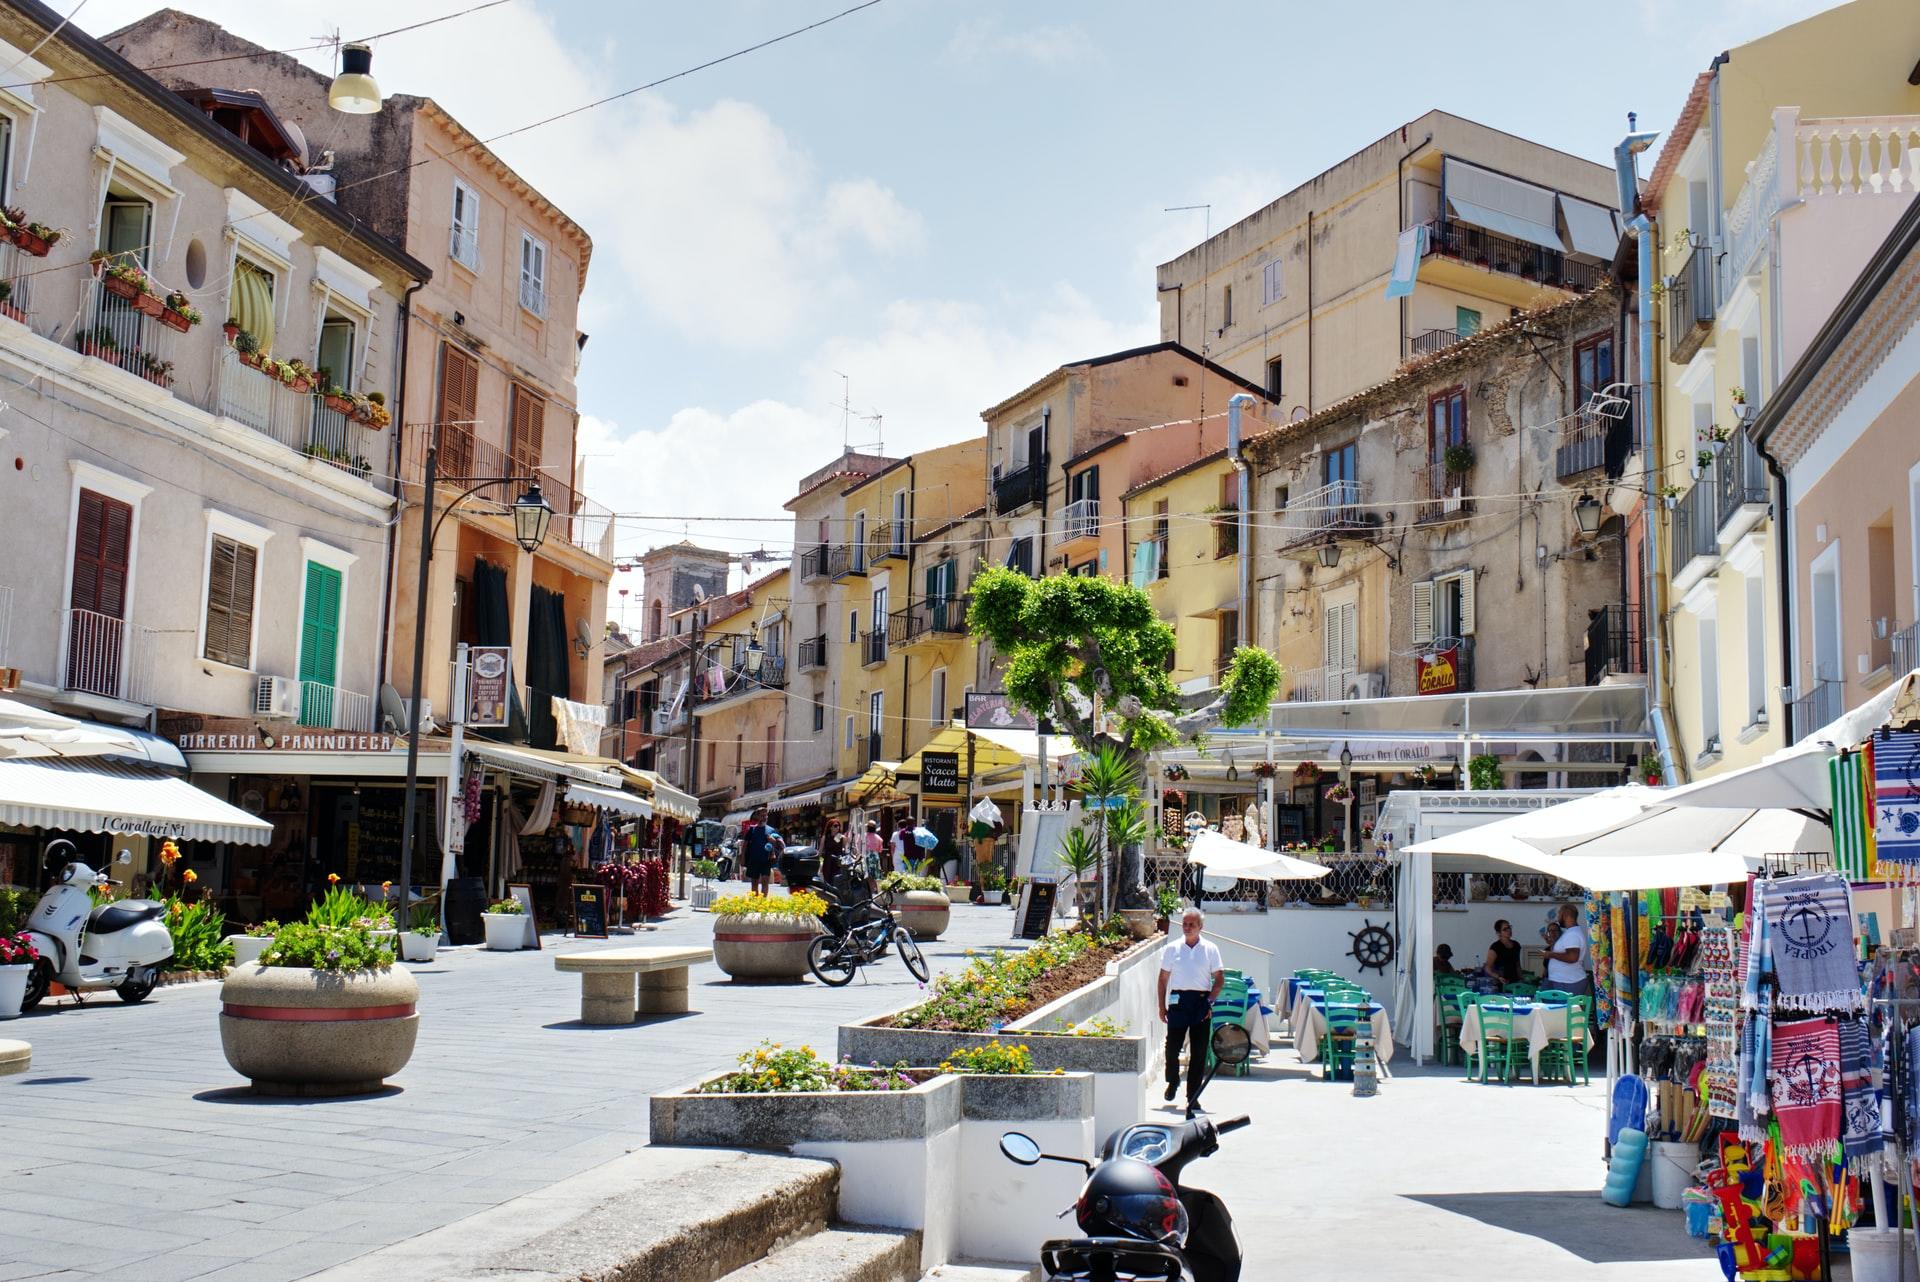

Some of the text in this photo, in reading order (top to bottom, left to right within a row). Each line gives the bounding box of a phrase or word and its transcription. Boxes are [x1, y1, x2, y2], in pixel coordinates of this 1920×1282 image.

[1421, 673, 1453, 691] CORALLO
[969, 694, 987, 702] BAR
[967, 699, 1003, 727] GELATERIA
[179, 734, 256, 749] BIRRERIA
[281, 735, 391, 751] PANINOTECA
[924, 765, 956, 776] Scacco
[925, 776, 956, 787] Matto
[111, 817, 168, 835] Corallari
[1784, 940, 1837, 960] TROPEA
